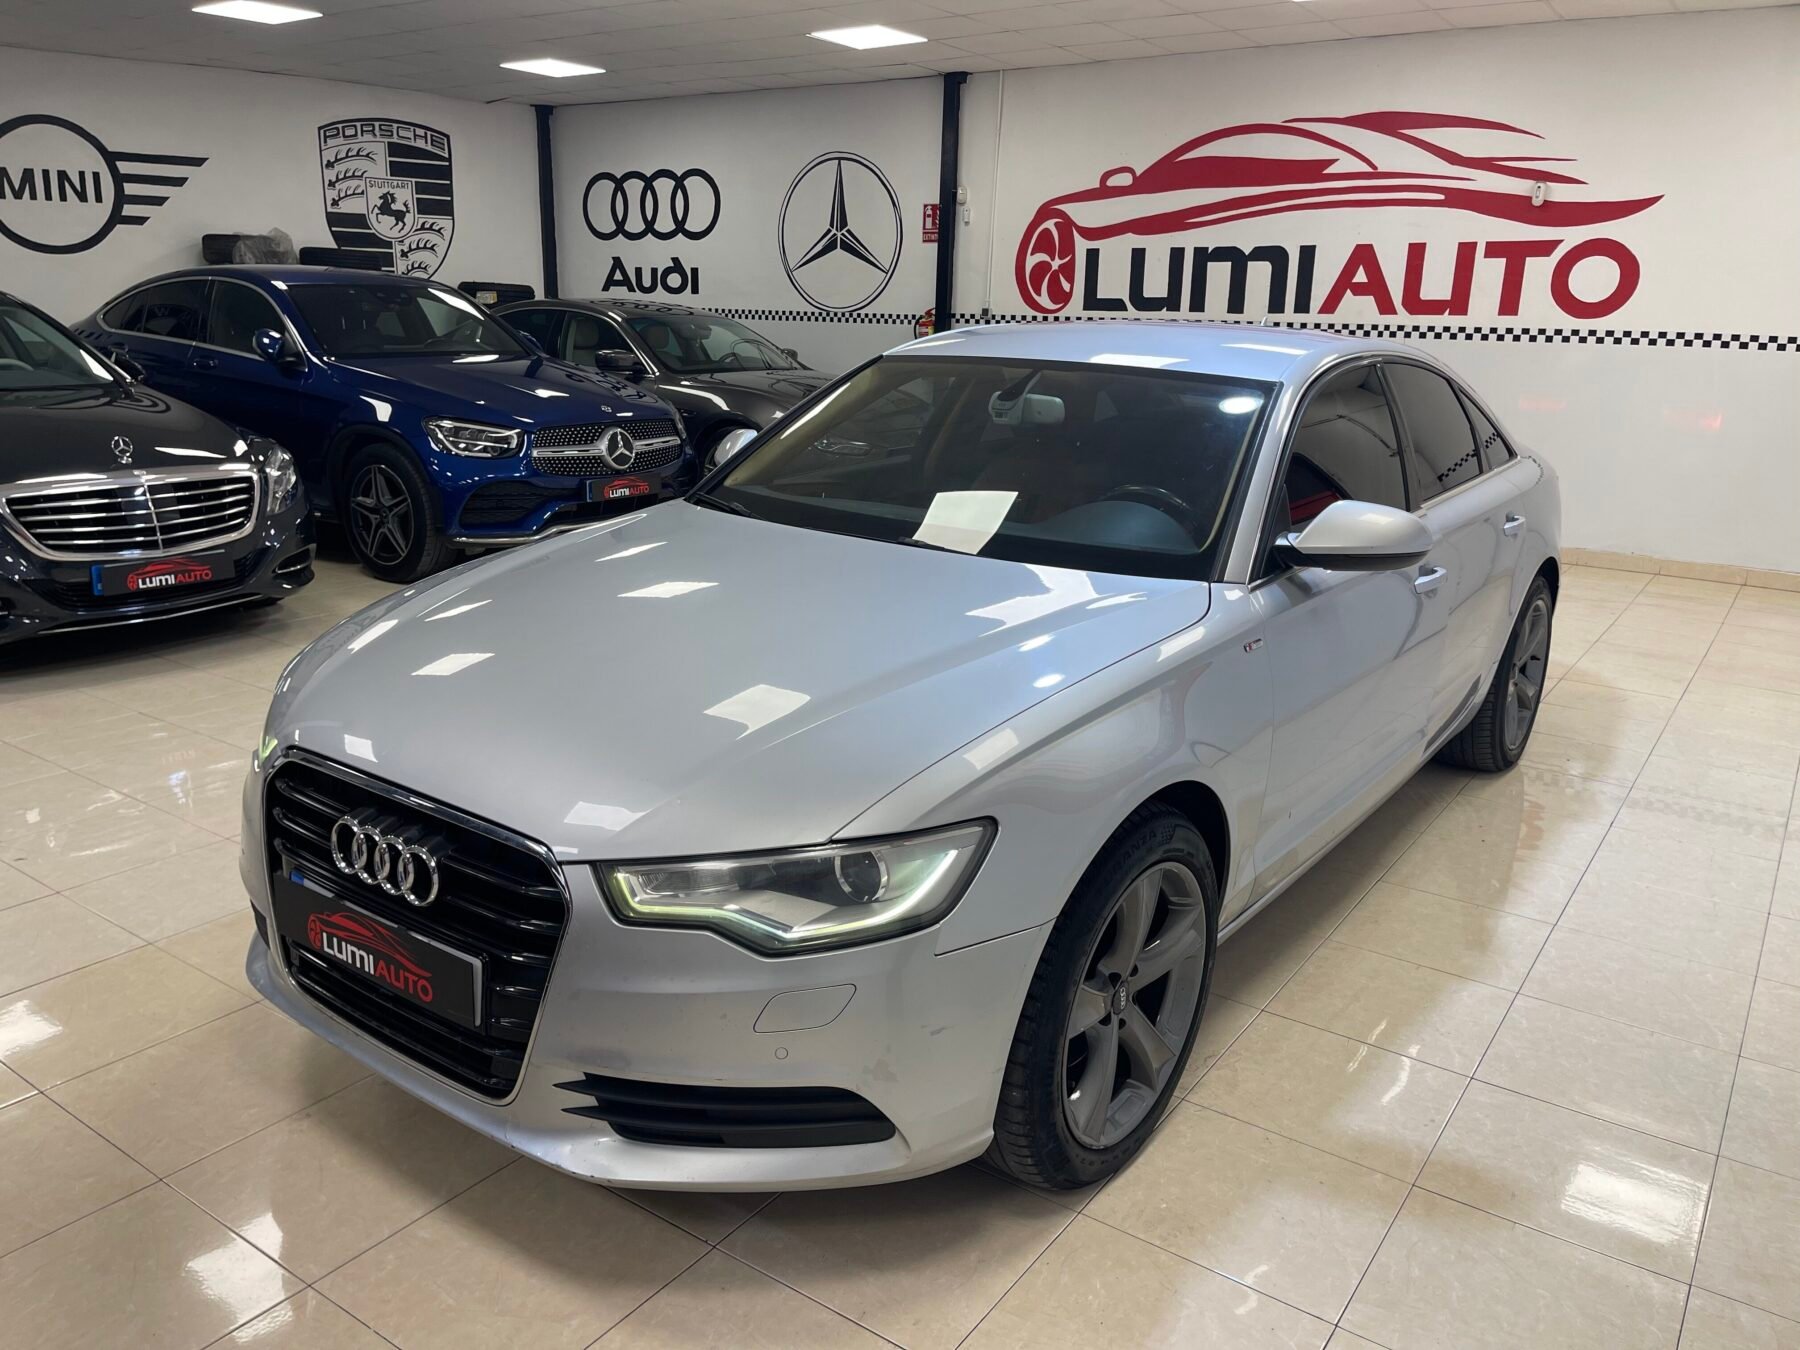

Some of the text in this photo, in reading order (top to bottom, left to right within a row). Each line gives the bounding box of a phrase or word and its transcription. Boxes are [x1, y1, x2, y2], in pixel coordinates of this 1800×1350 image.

[323, 123, 446, 153] PORSCHE
[0, 166, 103, 204] MINI
[368, 180, 410, 190] STUTTGART
